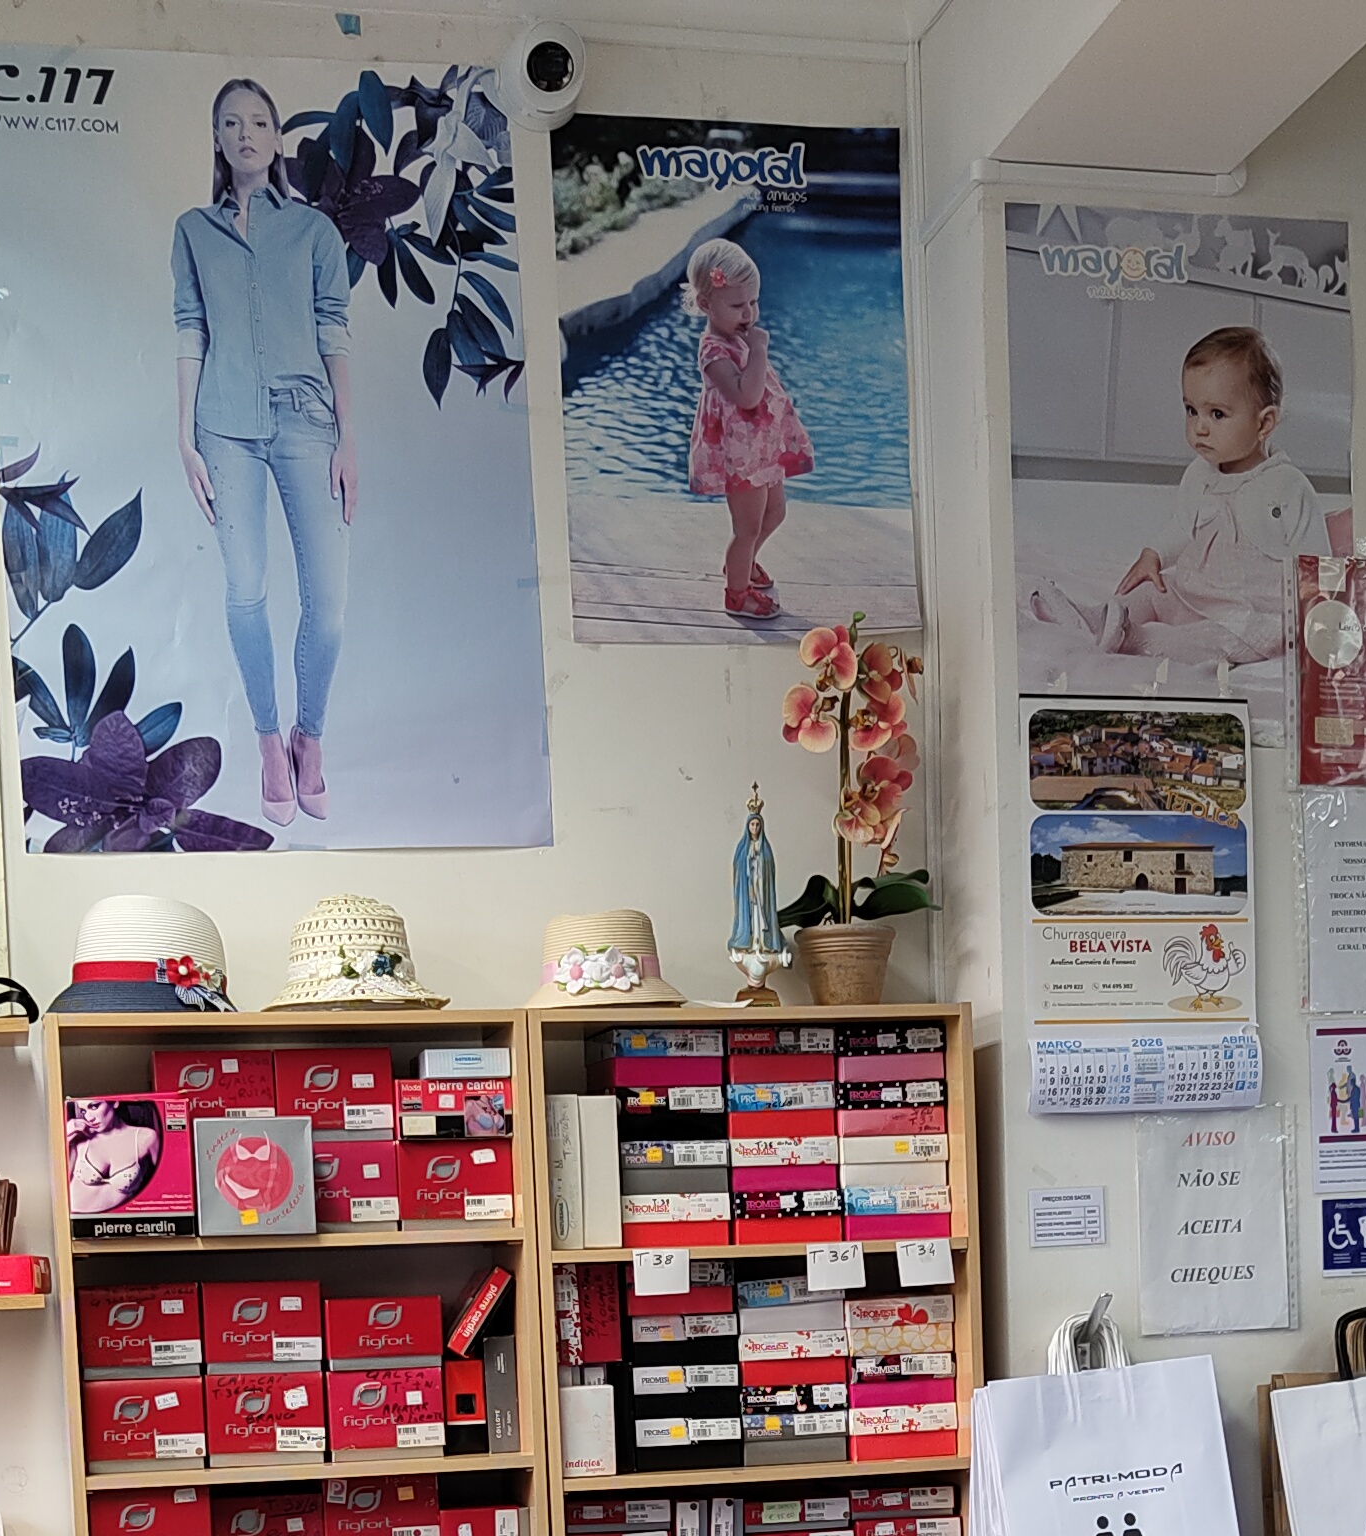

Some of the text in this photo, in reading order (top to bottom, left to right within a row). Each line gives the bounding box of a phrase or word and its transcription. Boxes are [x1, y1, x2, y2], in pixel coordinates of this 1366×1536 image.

[636, 143, 806, 190] mayoral
[766, 189, 808, 203] amigos
[1040, 244, 1186, 283] mayoral
[1088, 284, 1155, 301] newborn
[1165, 788, 1240, 830] Tarouca
[1042, 926, 1127, 944] Churrasqueira
[1069, 939, 1152, 953] BELA VISTA
[1036, 1035, 1257, 1050] MARÇO 2026 ABRIL
[428, 1080, 504, 1093] pierre cardin
[1181, 1130, 1236, 1148] AVISO
[1177, 1168, 1241, 1188] NÃO SE
[94, 1220, 176, 1237] pierre cardin
[1177, 1218, 1243, 1236] ACEITA
[653, 1253, 674, 1266] 38
[1170, 1264, 1255, 1284] CHEQUES
[461, 1283, 498, 1339] pierre cardin
[358, 1333, 414, 1350] figfort
[343, 1412, 398, 1430] figfort
[1049, 1463, 1183, 1497] PATRI-MODA
[338, 1517, 393, 1534] figfort
